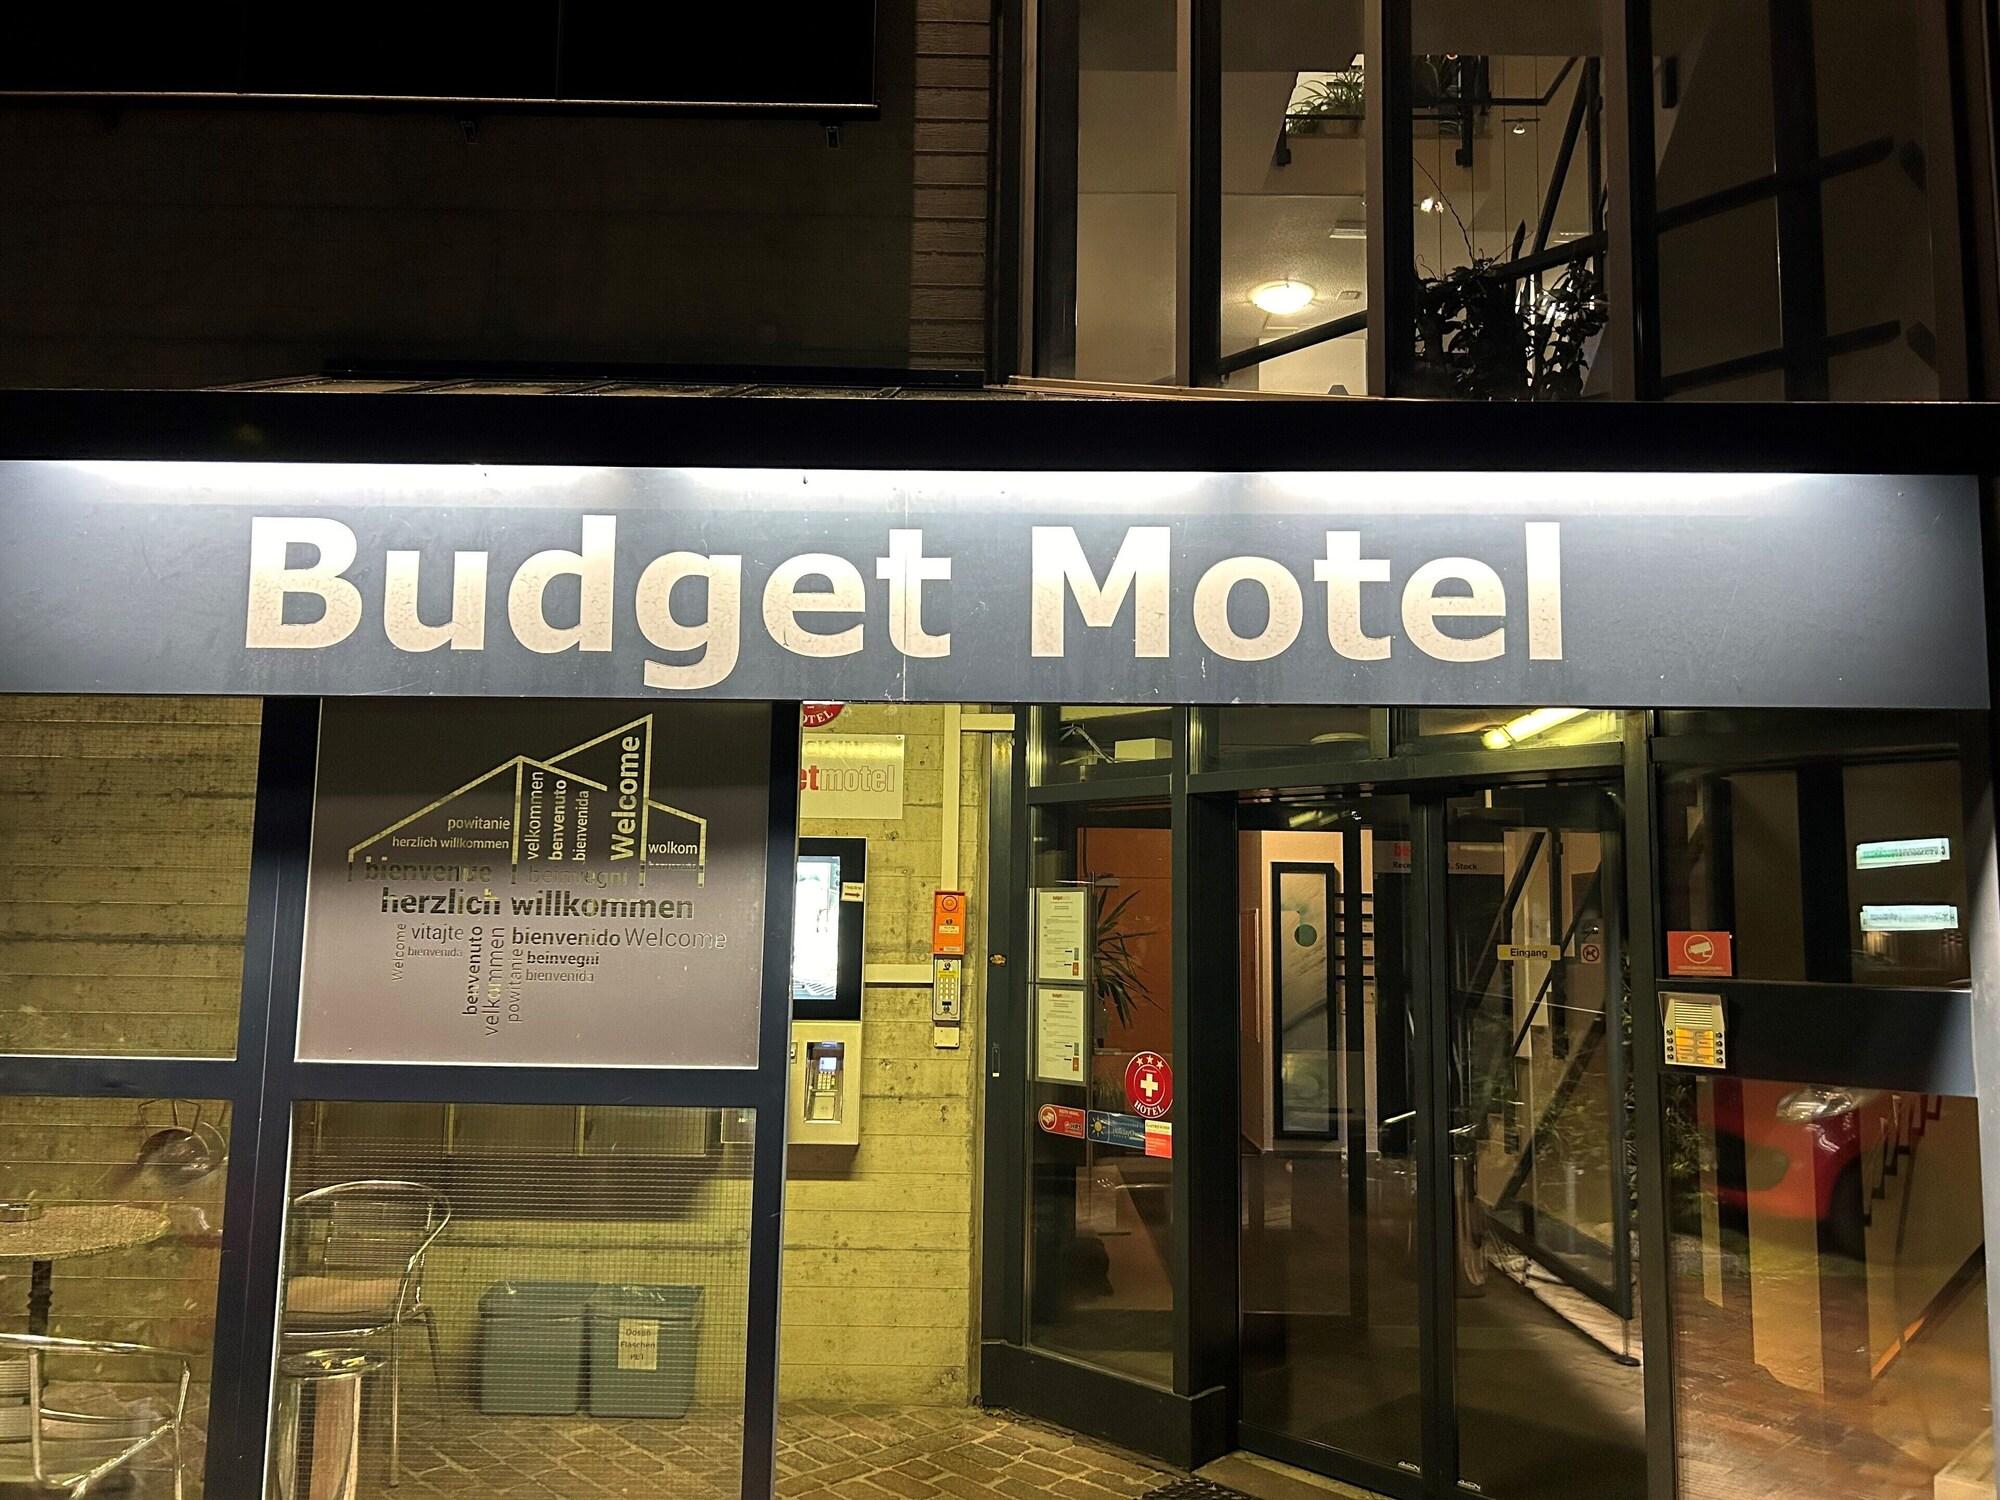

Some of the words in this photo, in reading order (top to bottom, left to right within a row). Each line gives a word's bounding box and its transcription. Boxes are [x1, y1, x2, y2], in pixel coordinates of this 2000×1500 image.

[246, 515, 951, 689] Budget
[1031, 521, 1562, 662] Motel
[800, 765, 895, 792] etmotel
[610, 736, 640, 861] Welcome
[447, 816, 511, 832] powitanie
[524, 771, 544, 860] velkommen
[548, 780, 567, 861] benvenuto
[572, 790, 590, 861] bienvenida
[392, 836, 438, 848] herzlich
[440, 837, 510, 849] willkommen
[648, 840, 698, 854] wolkom
[381, 887, 501, 915] herzlich
[511, 890, 694, 918] willkommen
[411, 923, 465, 944] vitajte
[511, 927, 621, 947] bienvenido
[624, 928, 727, 949] Welcome
[391, 923, 407, 983] Welcome
[407, 946, 463, 957] bienvenida
[527, 950, 600, 968] beinvegni
[1510, 947, 1548, 958] Eingang
[462, 926, 483, 1015] benvenuto
[481, 927, 505, 1036] velkommen
[525, 969, 594, 983] bienvenida
[508, 948, 524, 1023] powitanie
[1134, 1100, 1164, 1116] HOTEL
